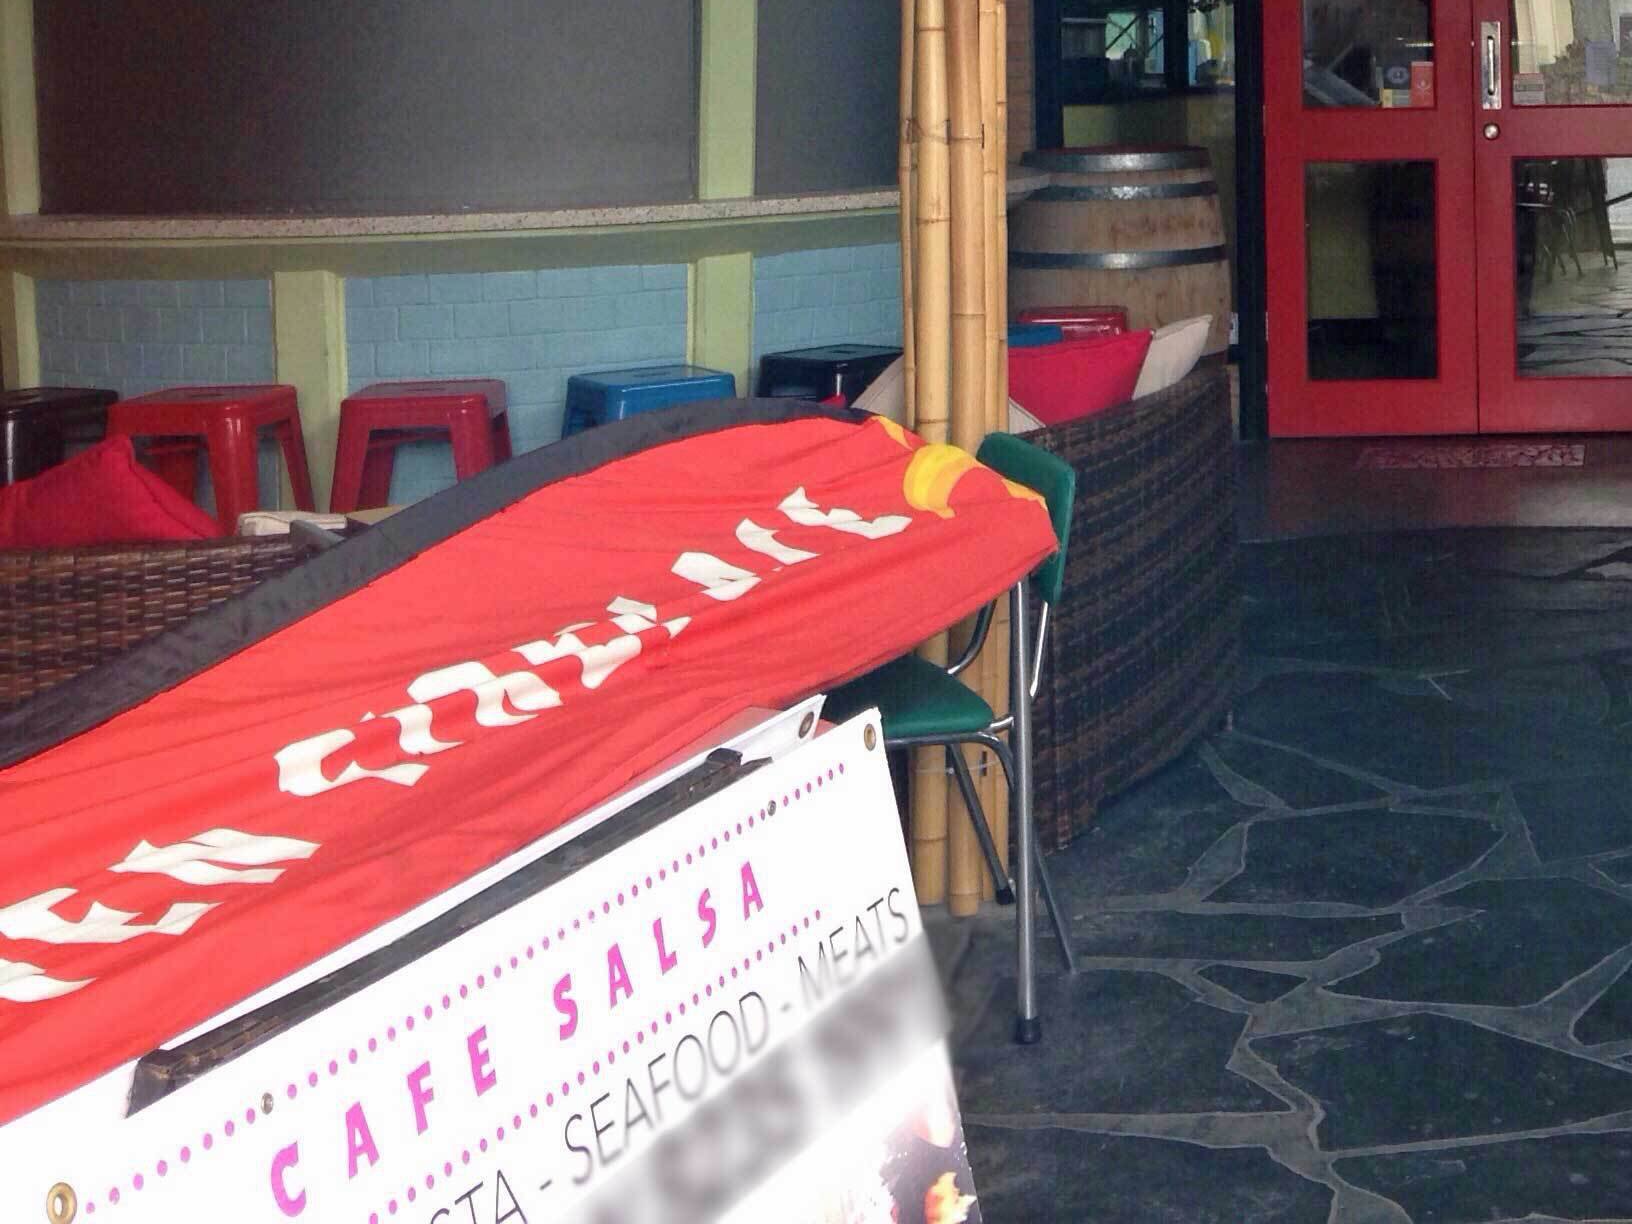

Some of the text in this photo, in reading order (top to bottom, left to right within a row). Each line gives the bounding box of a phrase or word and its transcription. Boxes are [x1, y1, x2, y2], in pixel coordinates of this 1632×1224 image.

[270, 1025, 497, 1218] CAFE
[552, 861, 765, 1041] SALSA
[564, 990, 770, 1186] SEAFOOD
[798, 887, 909, 1009] MEATS
